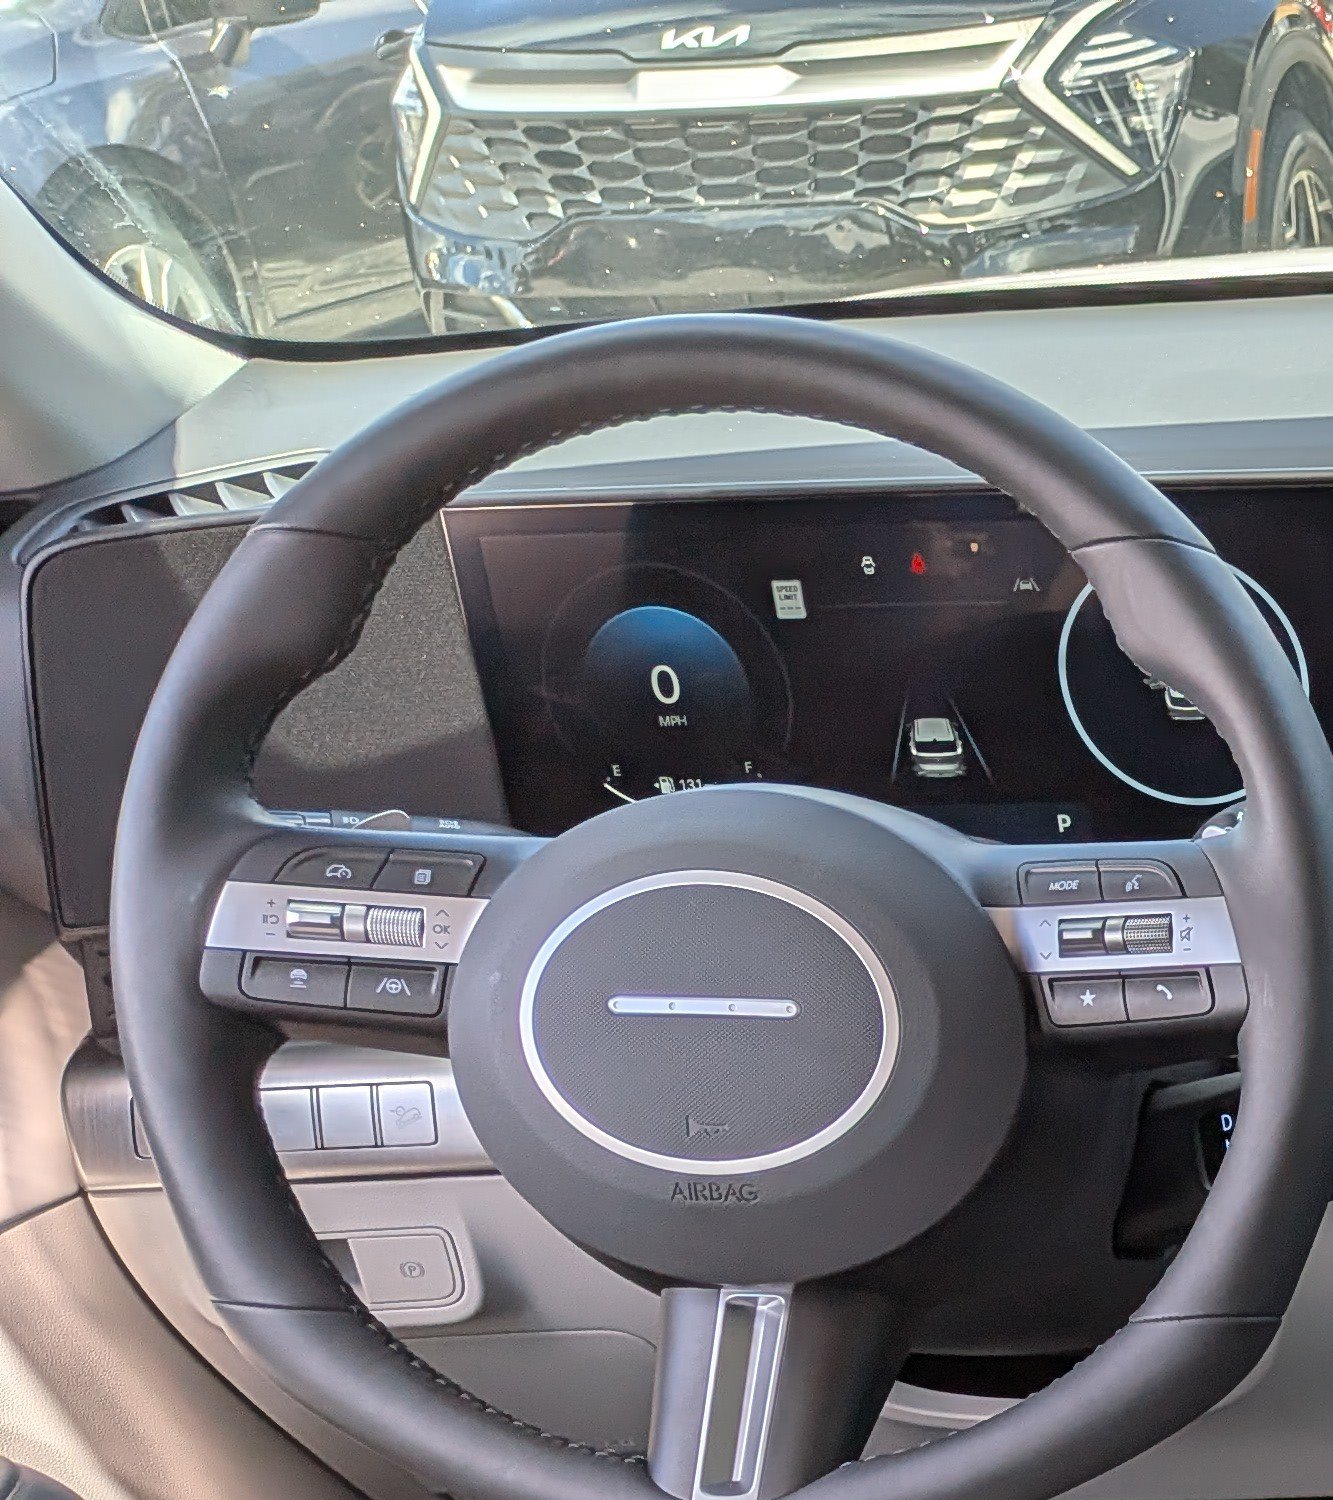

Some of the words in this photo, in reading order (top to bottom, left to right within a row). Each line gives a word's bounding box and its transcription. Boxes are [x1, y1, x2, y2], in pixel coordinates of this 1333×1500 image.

[775, 585, 798, 593] SPEED
[650, 665, 681, 705] 0
[658, 713, 688, 728] MPH
[612, 764, 621, 777] E
[745, 761, 753, 774] F
[678, 778, 702, 791] 131
[1058, 815, 1072, 832] P
[1048, 878, 1079, 893] MODE
[432, 922, 451, 936] OK
[1220, 1114, 1232, 1132] D
[670, 1180, 758, 1205] AIRBAG
